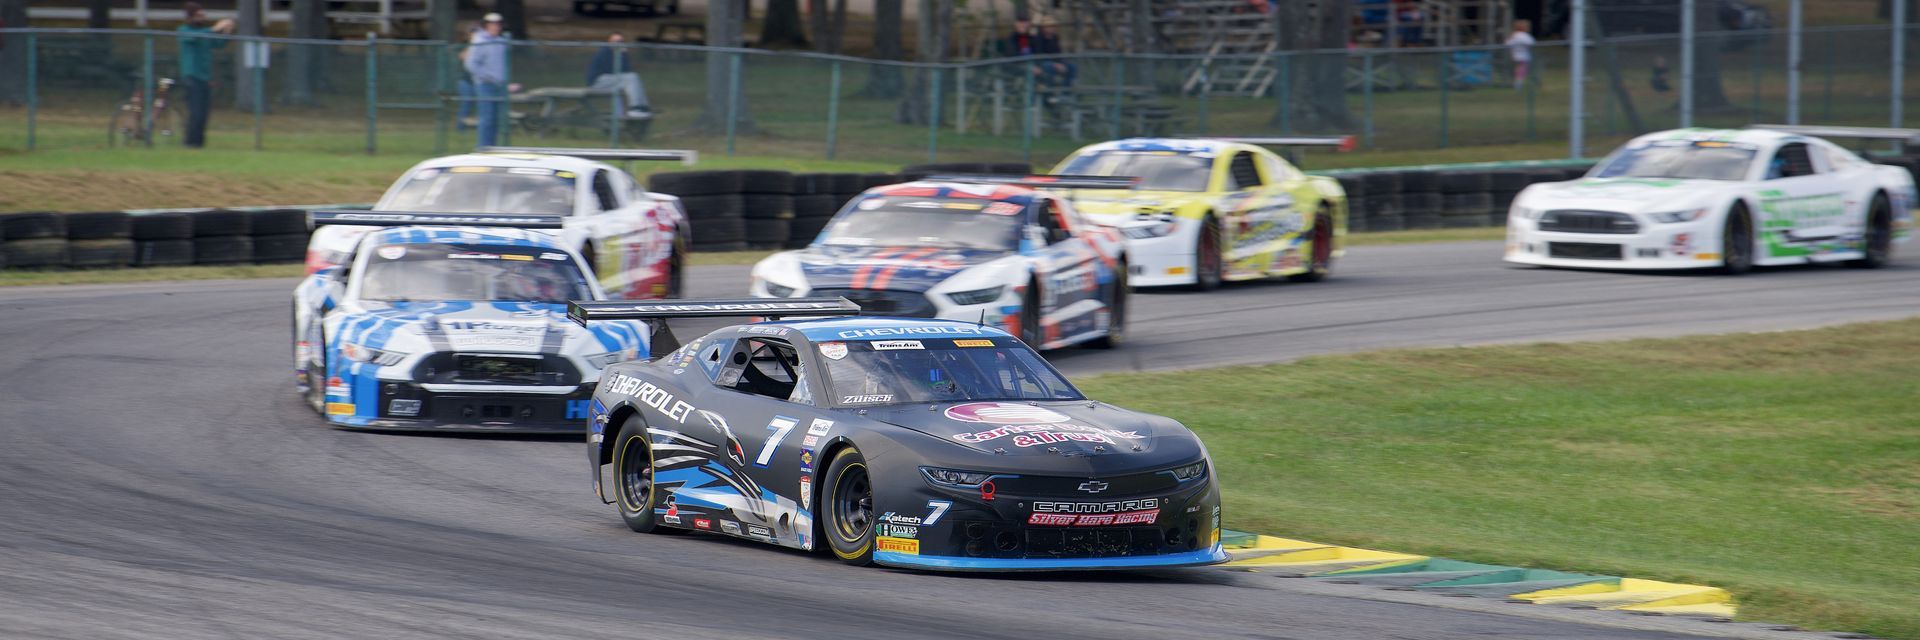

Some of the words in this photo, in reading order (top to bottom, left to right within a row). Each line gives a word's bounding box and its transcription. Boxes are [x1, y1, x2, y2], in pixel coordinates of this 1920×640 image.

[838, 326, 984, 340] CHEVROLET
[611, 374, 696, 424] CHEVROLET
[753, 415, 800, 467] 7
[1033, 498, 1158, 513] CAMARO
[885, 512, 921, 524] Katech
[921, 500, 953, 526] 7
[1029, 514, 1076, 525] Silver
[1076, 514, 1114, 525] Hare
[1113, 511, 1158, 524] Racing
[879, 540, 917, 552] PIRELLI
